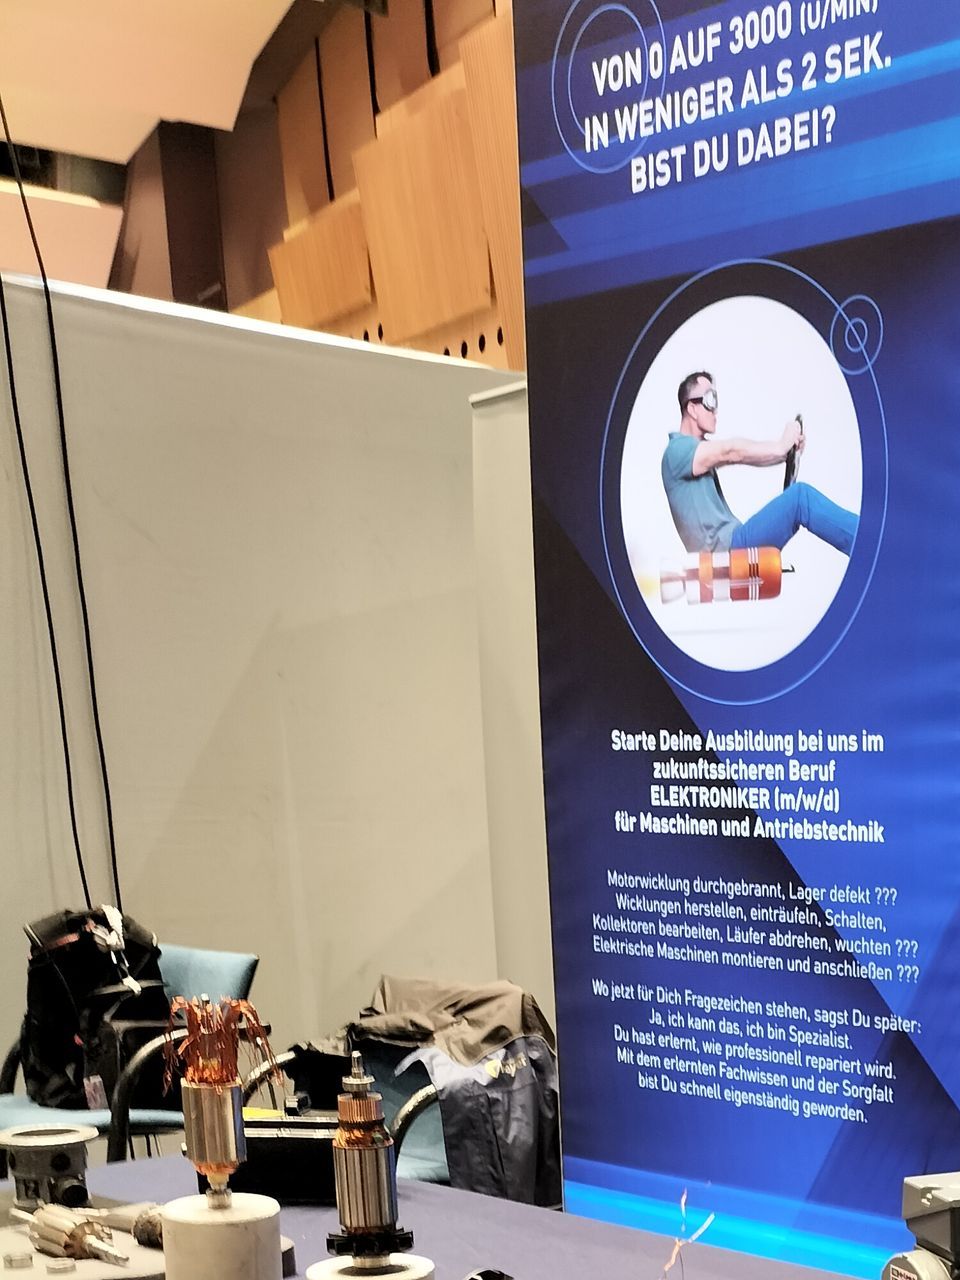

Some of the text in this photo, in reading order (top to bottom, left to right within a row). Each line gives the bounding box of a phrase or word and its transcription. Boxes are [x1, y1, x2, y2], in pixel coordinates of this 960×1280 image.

[592, 51, 642, 96] VON
[648, 48, 663, 80] 0
[669, 24, 723, 75] AUF
[729, 0, 792, 54] 3000
[584, 30, 891, 153] IN WENIGER ALS 2 SEK.
[631, 104, 837, 194] BIST DU DABEI?
[611, 729, 884, 757] Starte Deine Ausbildung bei uns im
[653, 758, 836, 782] zukunftssicheren Beruf
[650, 785, 840, 813] ELEKTRONIKER (m/w/d)
[615, 811, 885, 843] für Maschinen und Antriebstechnik
[607, 869, 897, 906] Motorwicklung durchgebrannt, Lager defekt ???
[593, 913, 919, 958] Kollektoren bearbeiten, Läufer abdrehen, wuchten ???
[615, 893, 887, 932] Wicklungen herstellen, einträufeln, Schalten,
[593, 935, 920, 983] Elektrische Maschinen montieren und anschließen ???
[592, 978, 922, 1034] Wo jetzt für Dich Fragezeichen stehen, sagst Du später:
[649, 1008, 853, 1050] Ja, ich kann das, ich bin Spezialist.
[614, 1024, 897, 1080] Du hast erlernt, wie professionell repariert wird.
[617, 1046, 894, 1104] Mit dem erlernten Fachwissen und der Sorgfalt
[638, 1071, 868, 1124] bist Du schnell eigenständig geworden.
